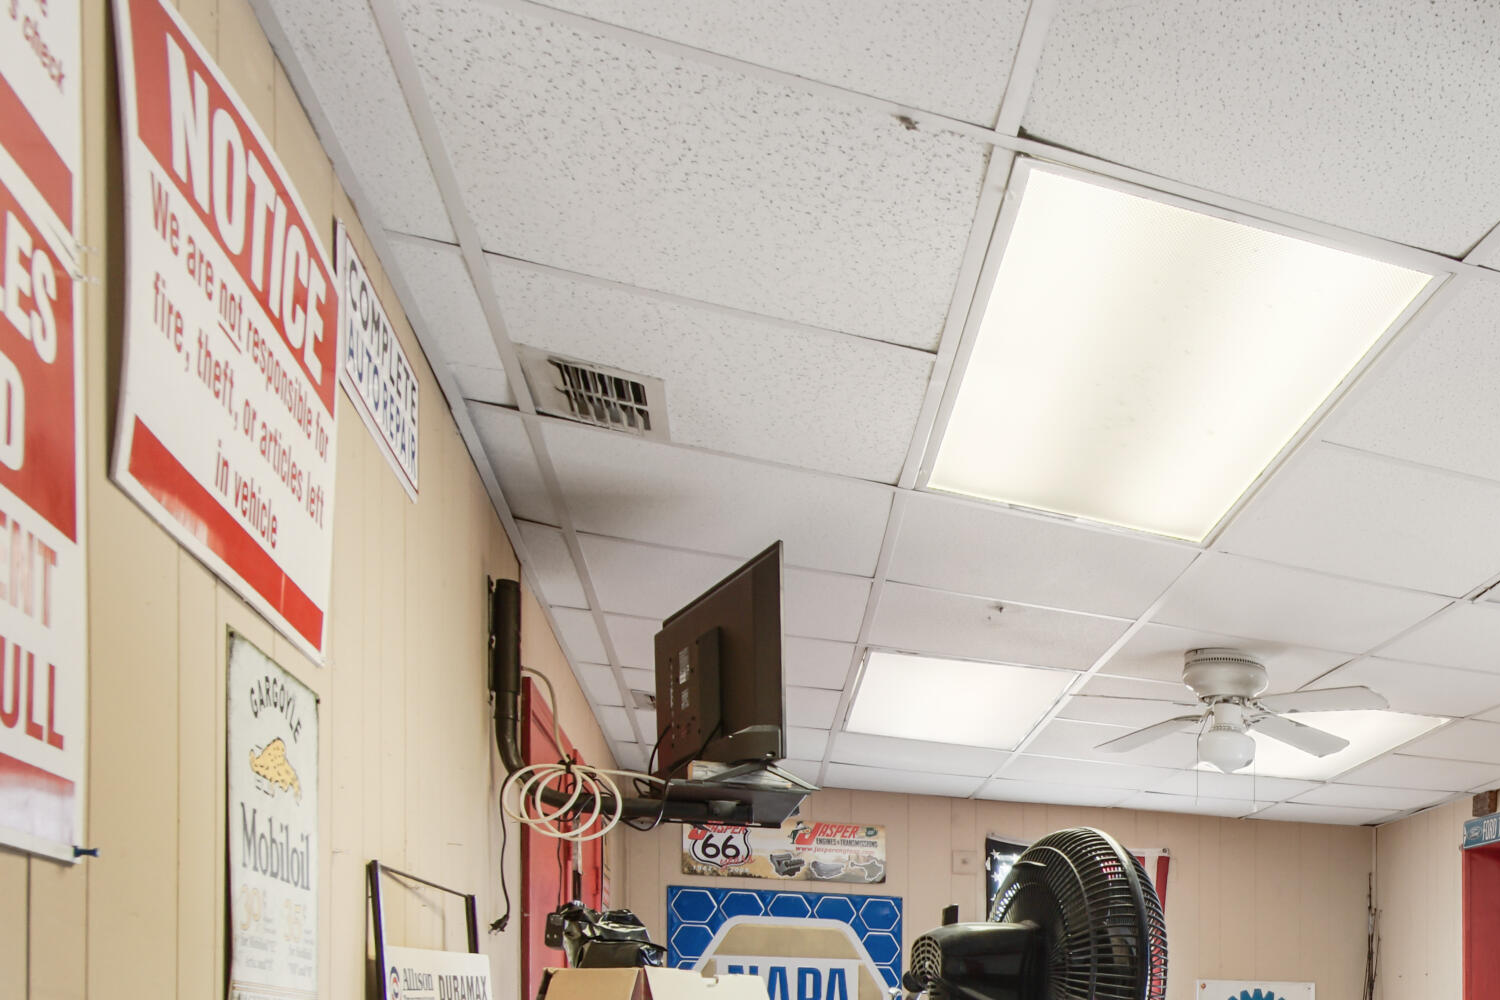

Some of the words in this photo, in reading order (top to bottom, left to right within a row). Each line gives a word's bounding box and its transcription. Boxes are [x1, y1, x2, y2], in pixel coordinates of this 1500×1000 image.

[166, 32, 327, 386] NOTICE
[150, 169, 180, 257] We
[186, 233, 214, 302] are
[218, 277, 243, 343] not
[246, 317, 313, 440] responsible
[315, 411, 329, 463] for
[349, 257, 417, 427] COMPLETE
[348, 319, 380, 412] AUTO
[382, 380, 417, 480] REPAIR
[215, 439, 230, 497] in
[234, 471, 278, 549] vehicle
[243, 398, 257, 442] or
[260, 421, 303, 502] articles
[306, 471, 325, 530] left
[250, 676, 302, 744] GARGOYLE
[241, 801, 311, 891] Mobiloil
[701, 834, 741, 859] 66
[796, 822, 859, 846] JASPER
